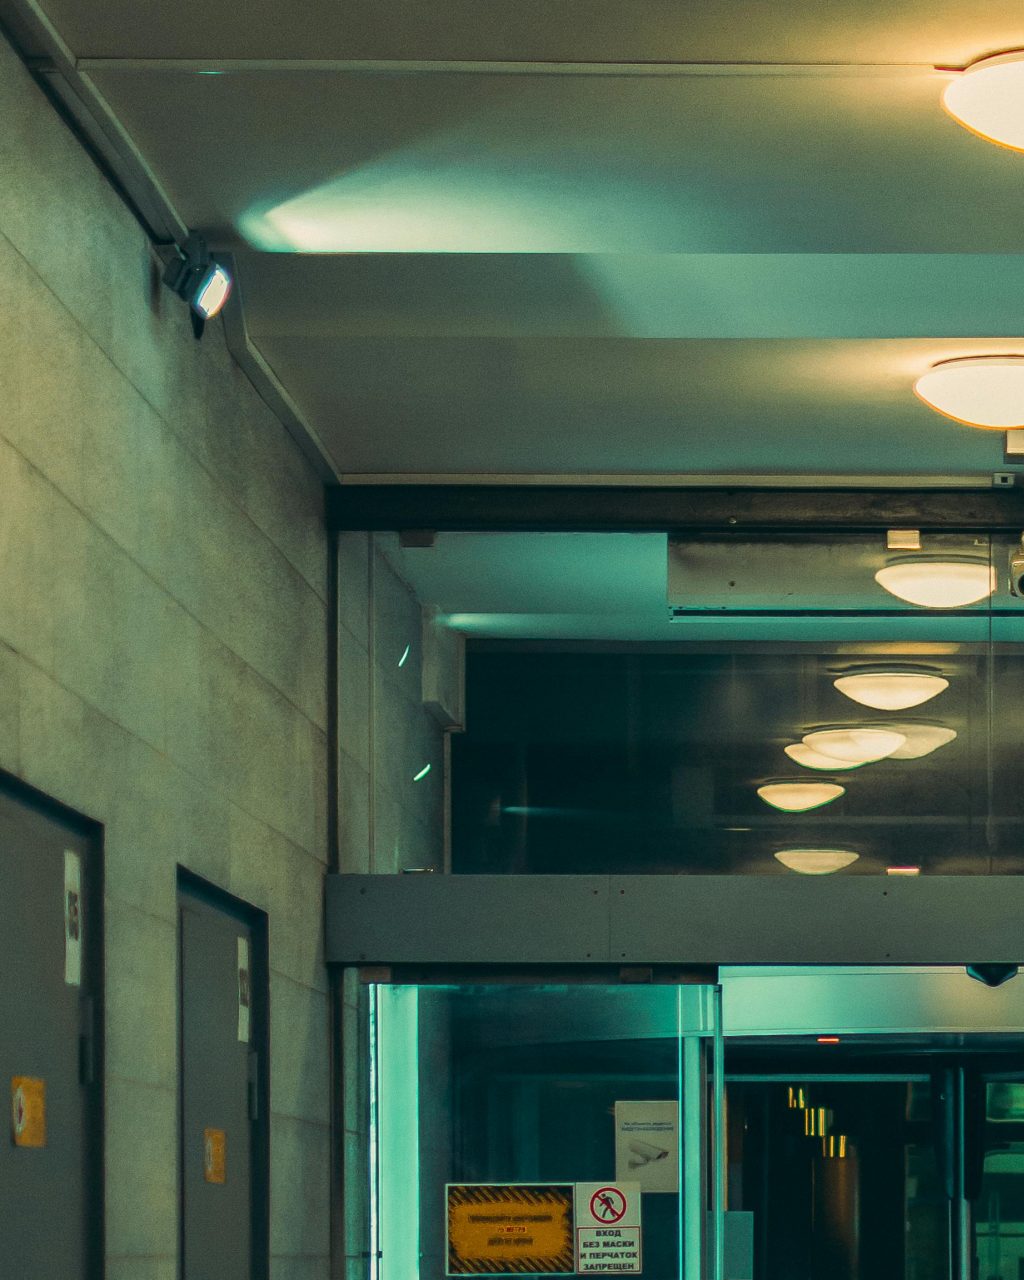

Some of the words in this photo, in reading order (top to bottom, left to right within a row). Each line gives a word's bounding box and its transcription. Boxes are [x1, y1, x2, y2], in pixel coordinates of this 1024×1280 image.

[580, 1252, 587, 1260] И
[589, 1252, 638, 1260] ПЕРЧАТОК
[583, 1263, 635, 1271] ЗАПРЕЩЕН
